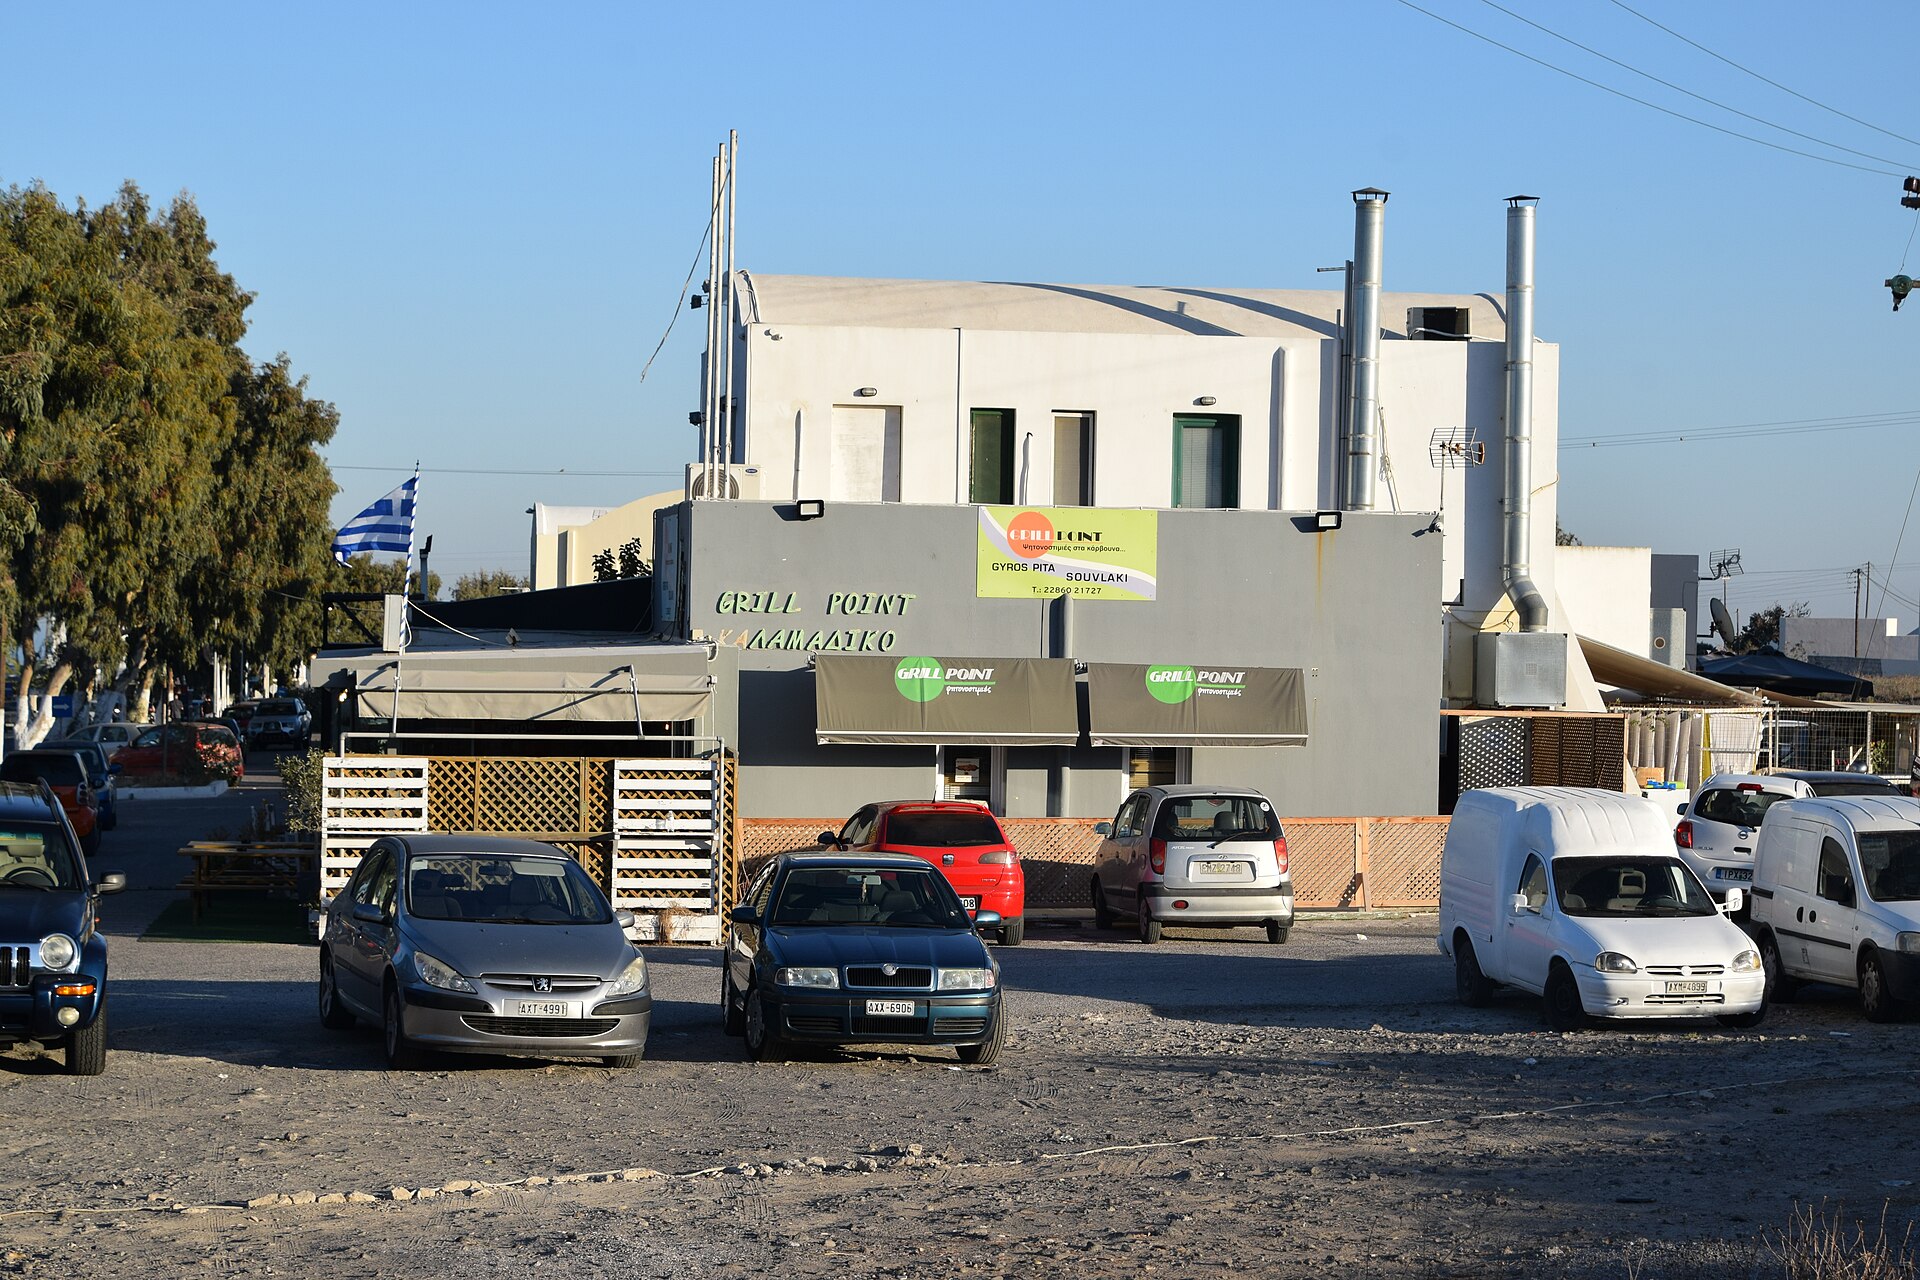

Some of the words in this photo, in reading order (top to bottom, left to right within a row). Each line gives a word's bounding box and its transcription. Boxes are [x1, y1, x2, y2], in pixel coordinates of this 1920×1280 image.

[1009, 529, 1051, 541] GRILL
[1057, 531, 1102, 542] POINT
[991, 562, 1028, 572] GYROS
[1032, 563, 1055, 572] PITA
[1066, 572, 1128, 583] SOUVLAKI
[1044, 586, 1072, 594] 22860
[1074, 587, 1102, 595] 21727
[715, 591, 801, 614] GRILL
[826, 593, 916, 615] POINT
[897, 667, 942, 680] GRILL
[945, 668, 995, 680] POINT
[1149, 671, 1193, 682] GRILL
[1196, 671, 1245, 683] POINT
